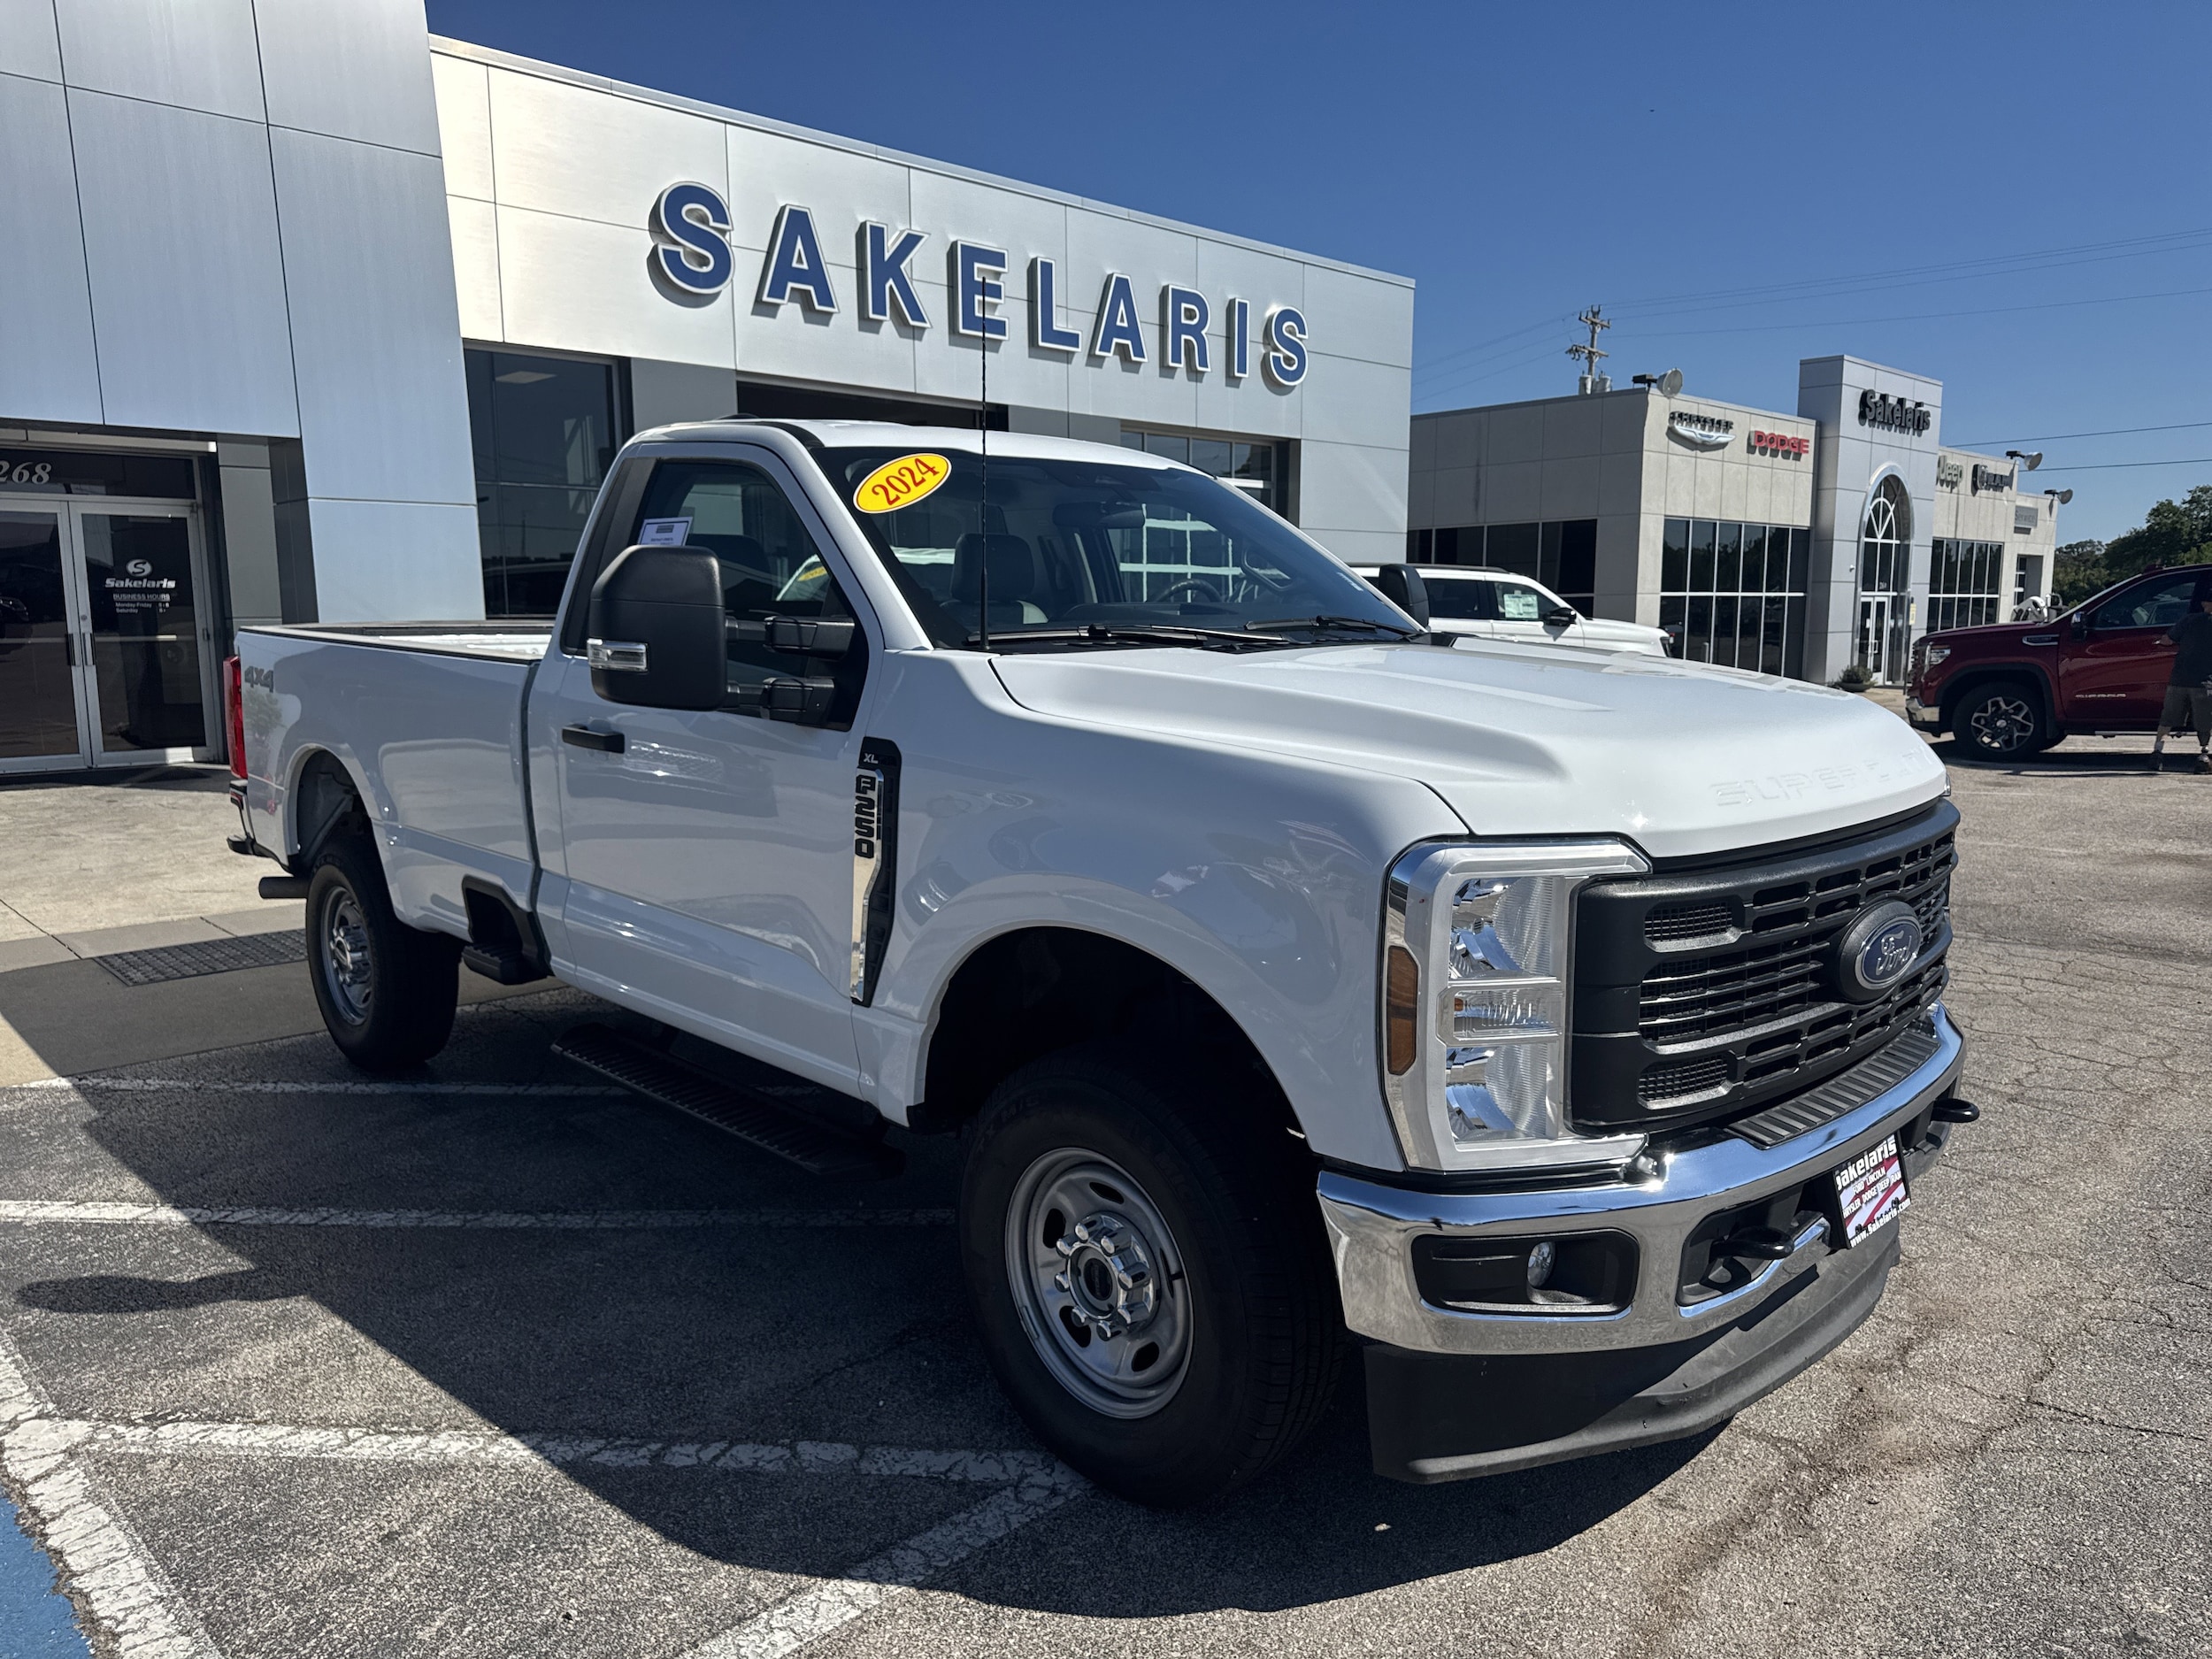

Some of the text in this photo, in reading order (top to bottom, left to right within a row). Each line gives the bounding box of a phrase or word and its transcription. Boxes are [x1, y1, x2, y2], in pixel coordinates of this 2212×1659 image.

[650, 180, 1310, 387] SAKELARIS
[1864, 389, 1932, 432] Sakelaris
[1753, 430, 1810, 455] DODGE
[872, 457, 940, 506] 2024
[1939, 456, 1964, 485] Jeep
[105, 577, 176, 588] Sakelaris
[864, 752, 879, 764] XL
[1876, 929, 1912, 976] Ford
[1842, 1197, 1862, 1218] HRYSLER
[1862, 1185, 1878, 1203] DODGE
